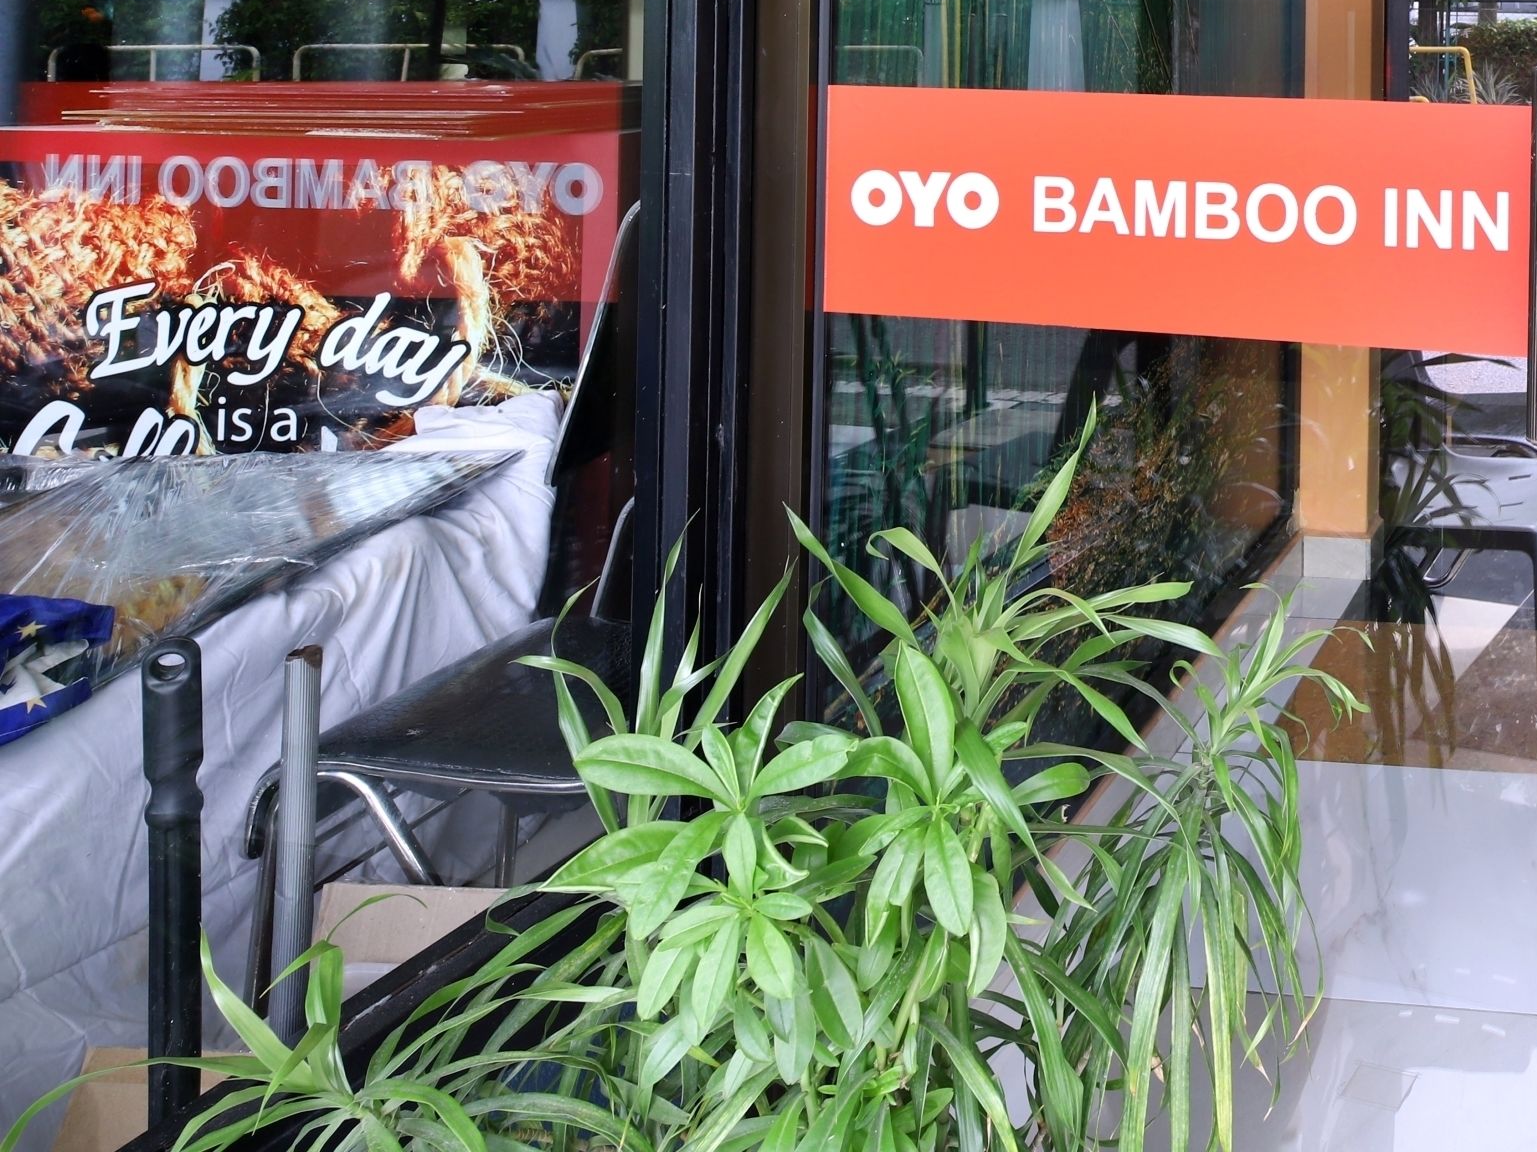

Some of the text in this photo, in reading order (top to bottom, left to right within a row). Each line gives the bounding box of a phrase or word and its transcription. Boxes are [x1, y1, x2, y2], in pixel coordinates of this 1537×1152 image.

[850, 168, 1512, 252] OYO BAMBOO INN
[84, 278, 470, 408] Every day
[216, 396, 253, 443] is
[269, 406, 298, 443] a
